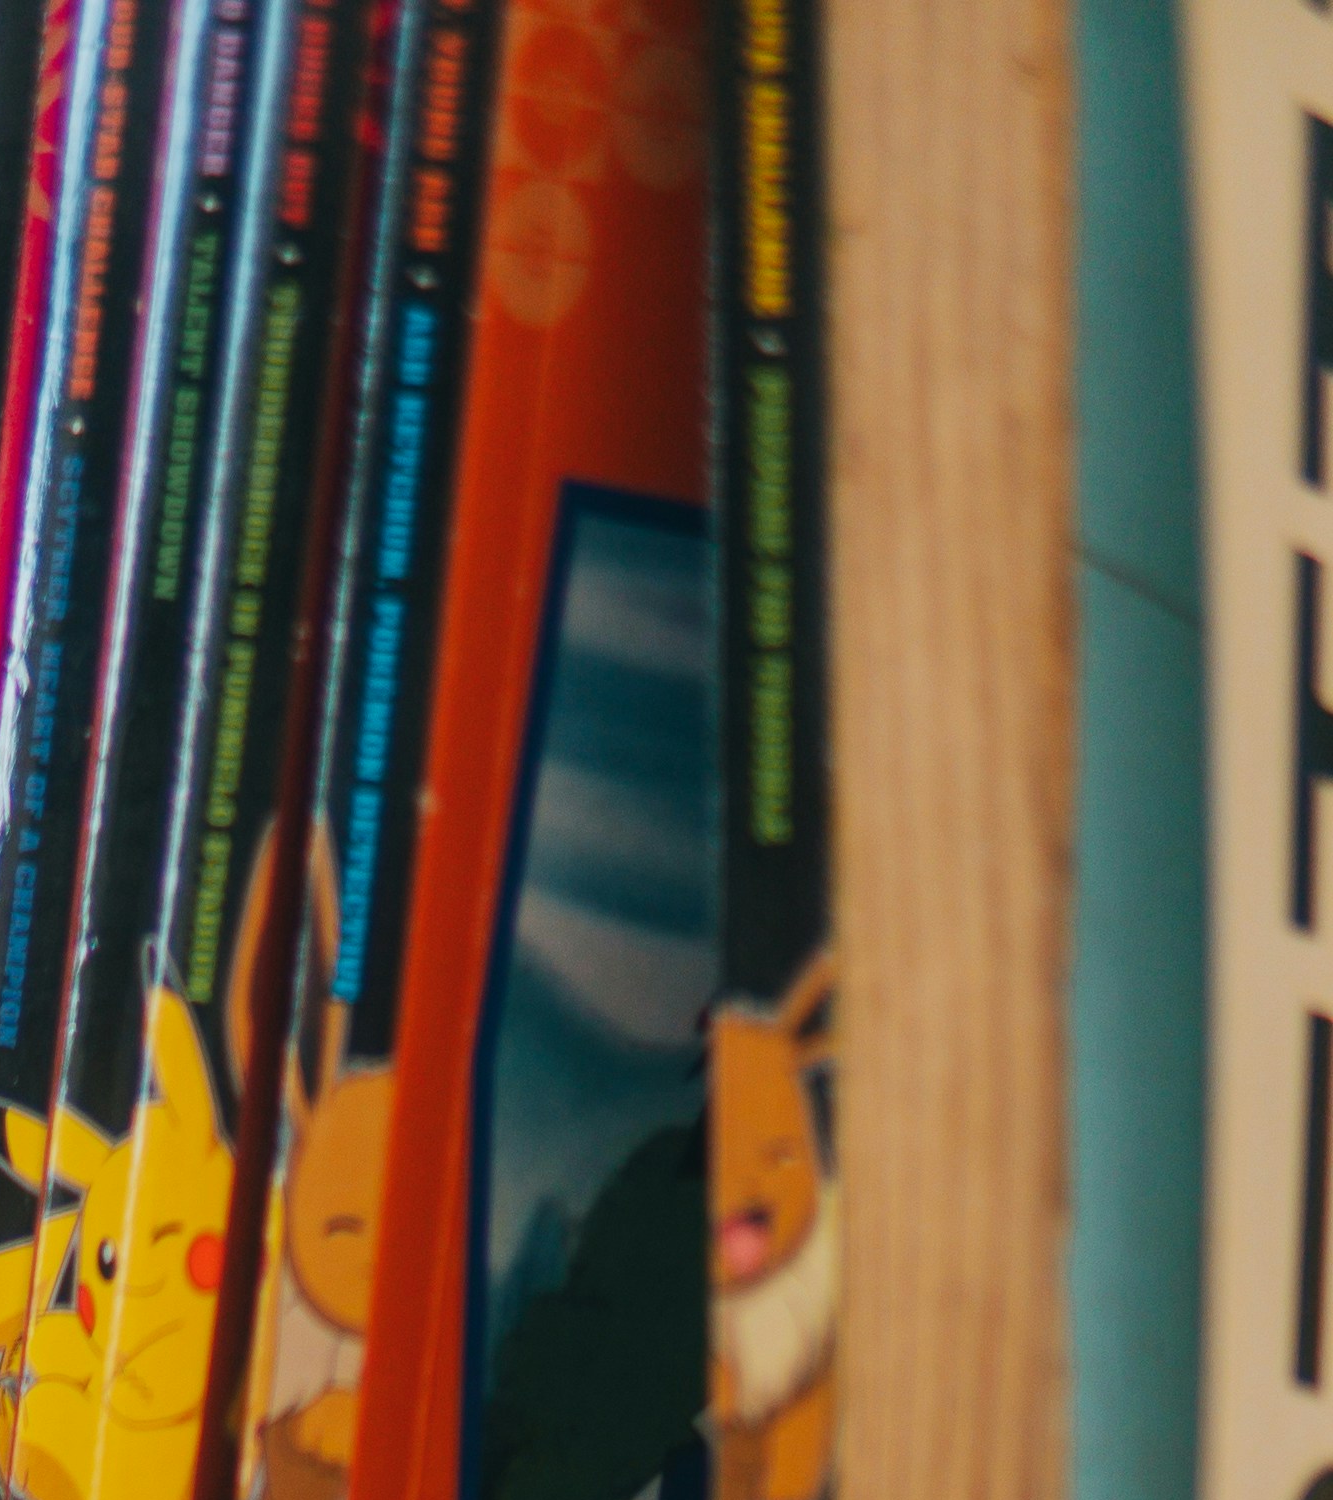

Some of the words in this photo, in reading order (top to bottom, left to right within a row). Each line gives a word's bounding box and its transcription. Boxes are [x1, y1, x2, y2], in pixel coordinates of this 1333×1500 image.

[67, 186, 120, 401] CHALLENGE
[178, 232, 222, 380] TALENT
[151, 388, 201, 602] SHOWDOWN
[25, 643, 66, 764] HEART
[21, 773, 48, 821] OF
